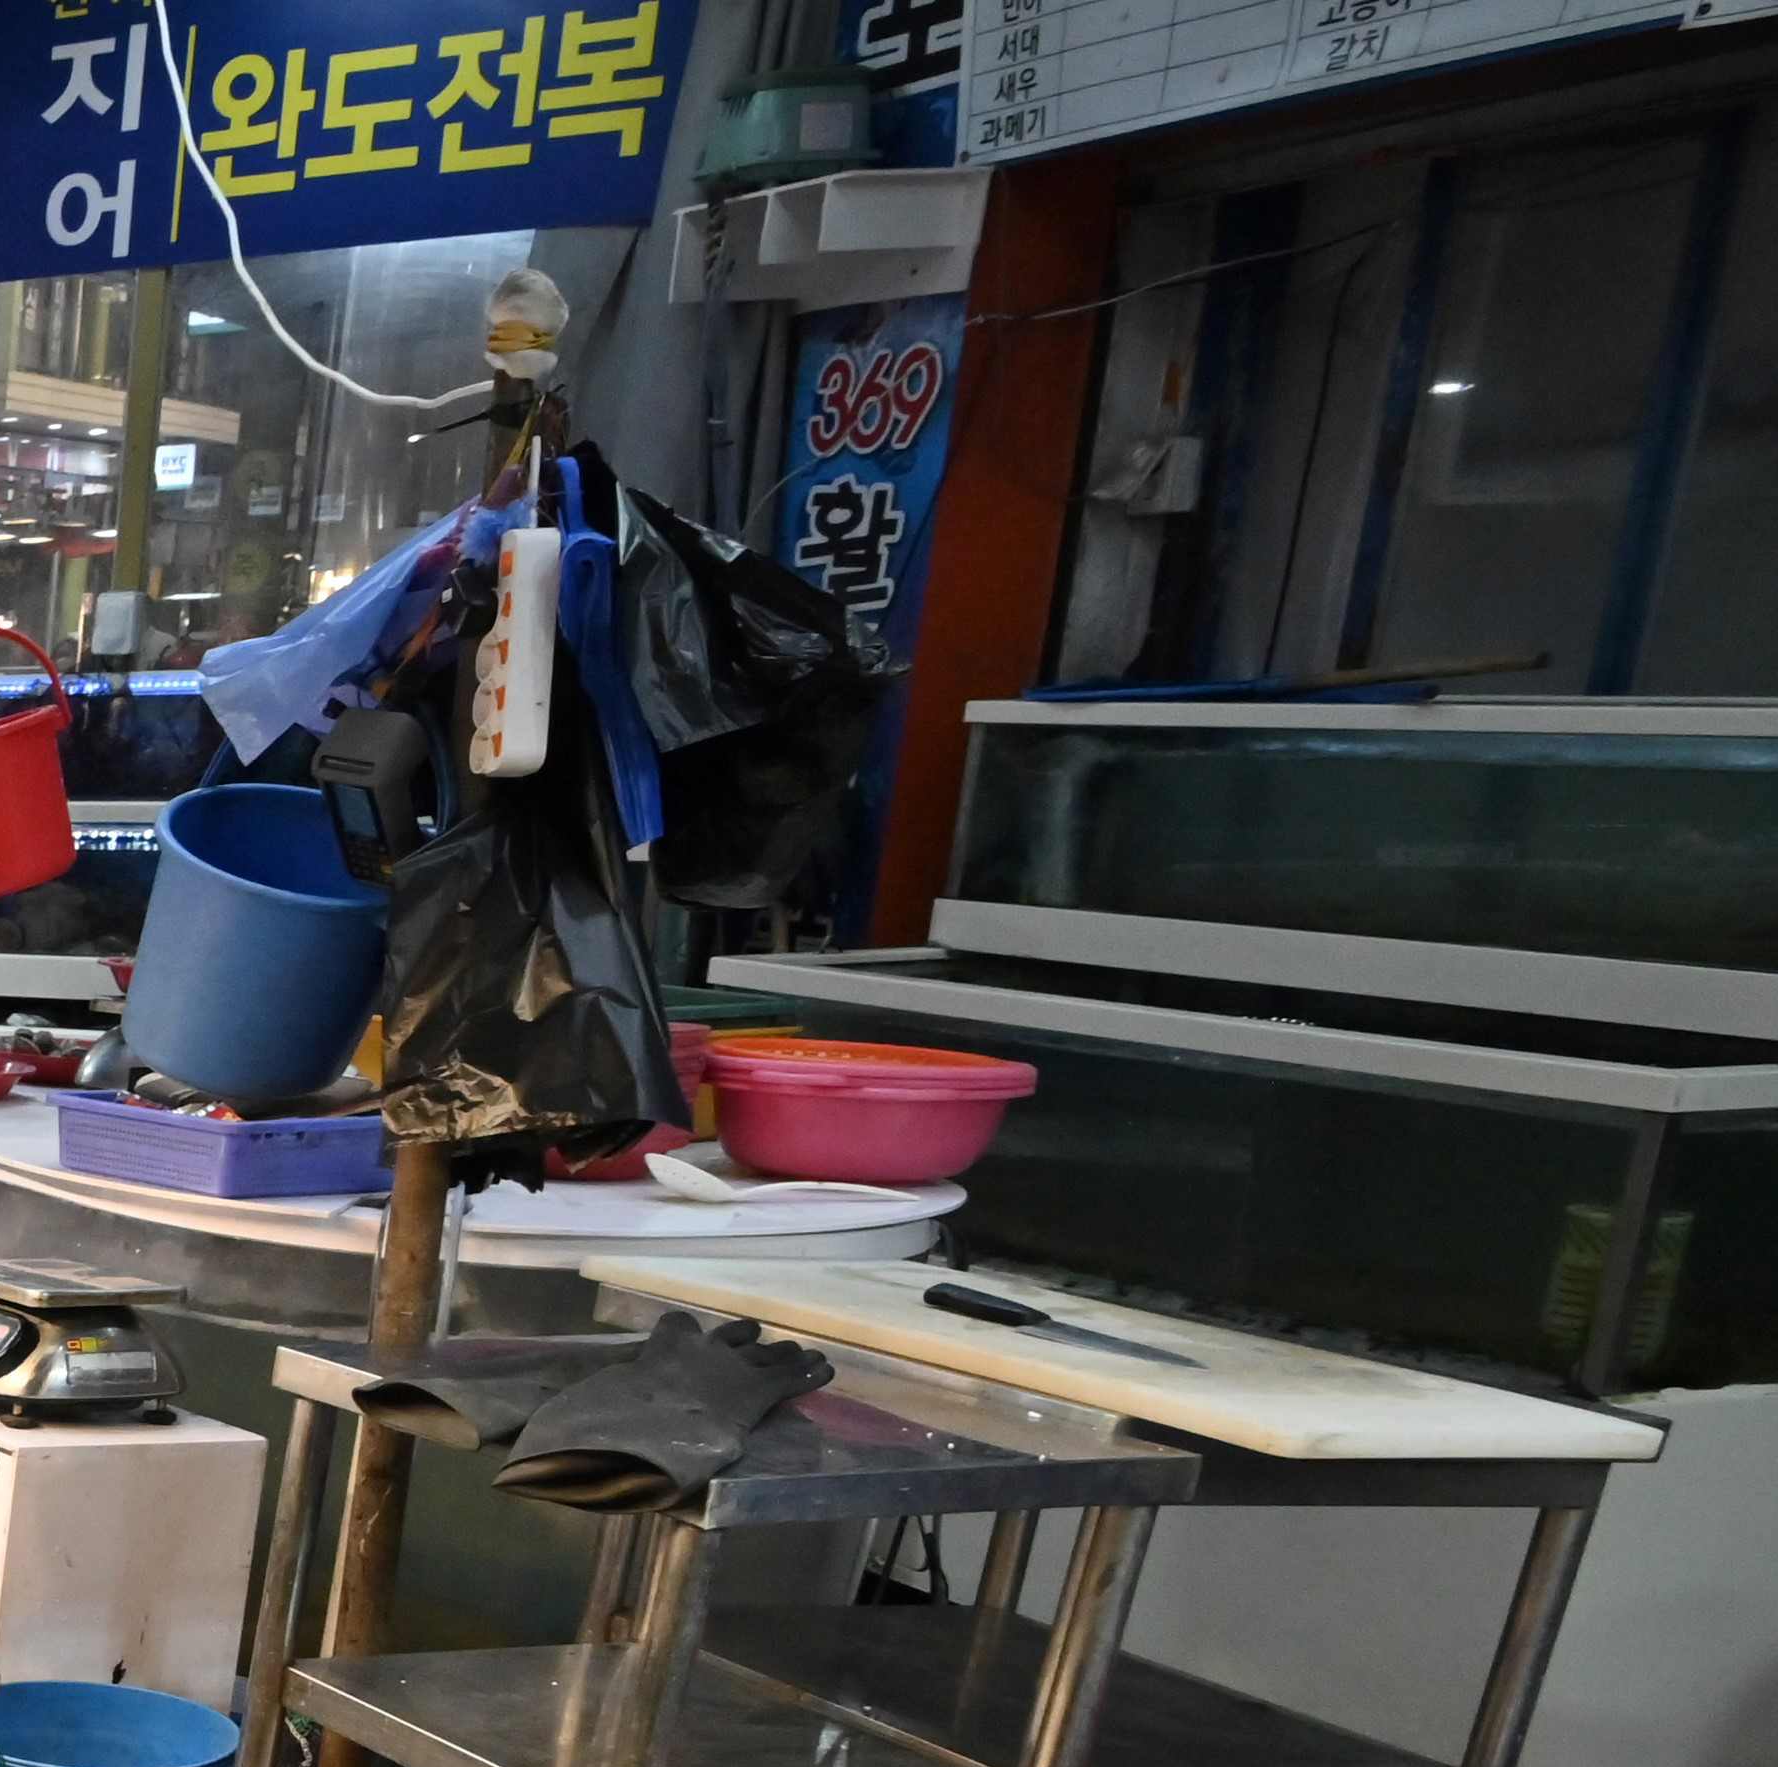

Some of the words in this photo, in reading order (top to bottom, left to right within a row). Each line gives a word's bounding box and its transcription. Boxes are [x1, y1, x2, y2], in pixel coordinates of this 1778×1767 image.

[998, 25, 1040, 61] 서대
[1326, 25, 1390, 72] 갈치
[200, 2, 664, 196] 완도전복
[995, 68, 1038, 101] 새우
[979, 105, 1045, 146] 과메기
[808, 342, 941, 456] 369
